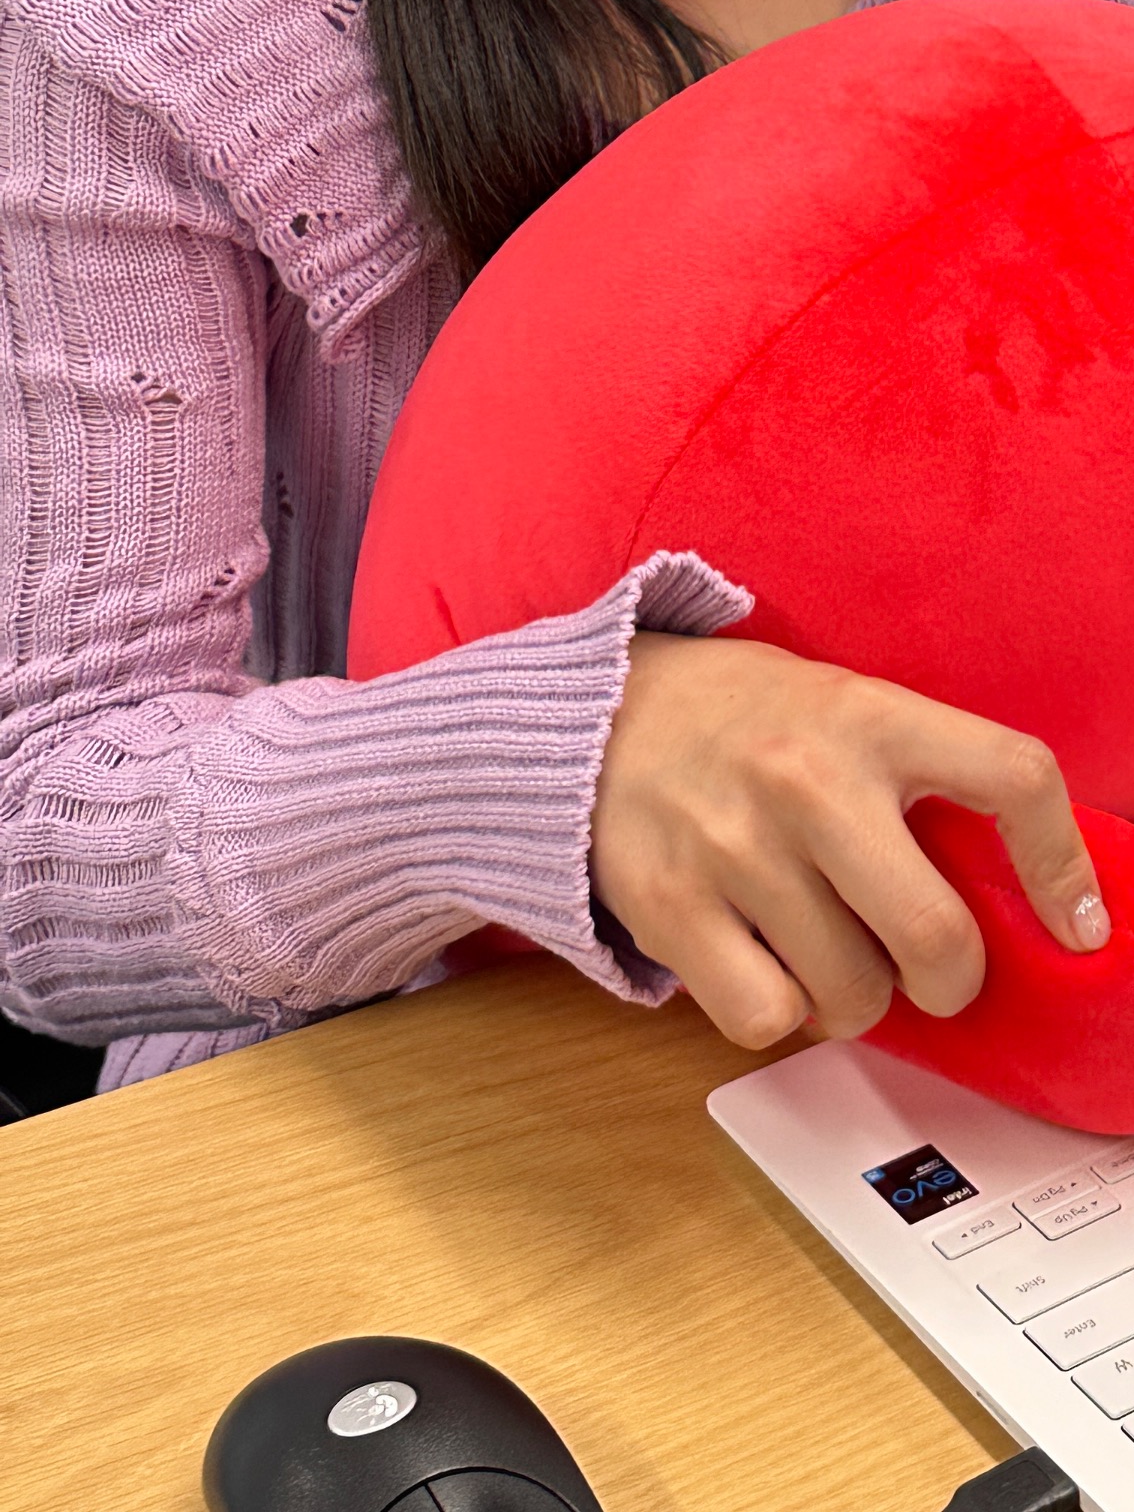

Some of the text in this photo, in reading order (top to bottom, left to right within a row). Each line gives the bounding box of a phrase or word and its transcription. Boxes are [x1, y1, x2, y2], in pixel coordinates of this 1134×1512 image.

[943, 1187, 972, 1205] intel
[1033, 1185, 1066, 1203] PgDn
[1055, 1206, 1088, 1224] PgUp
[971, 1220, 994, 1234] End
[1016, 1276, 1045, 1292] Shift
[1064, 1319, 1096, 1338] Enter
